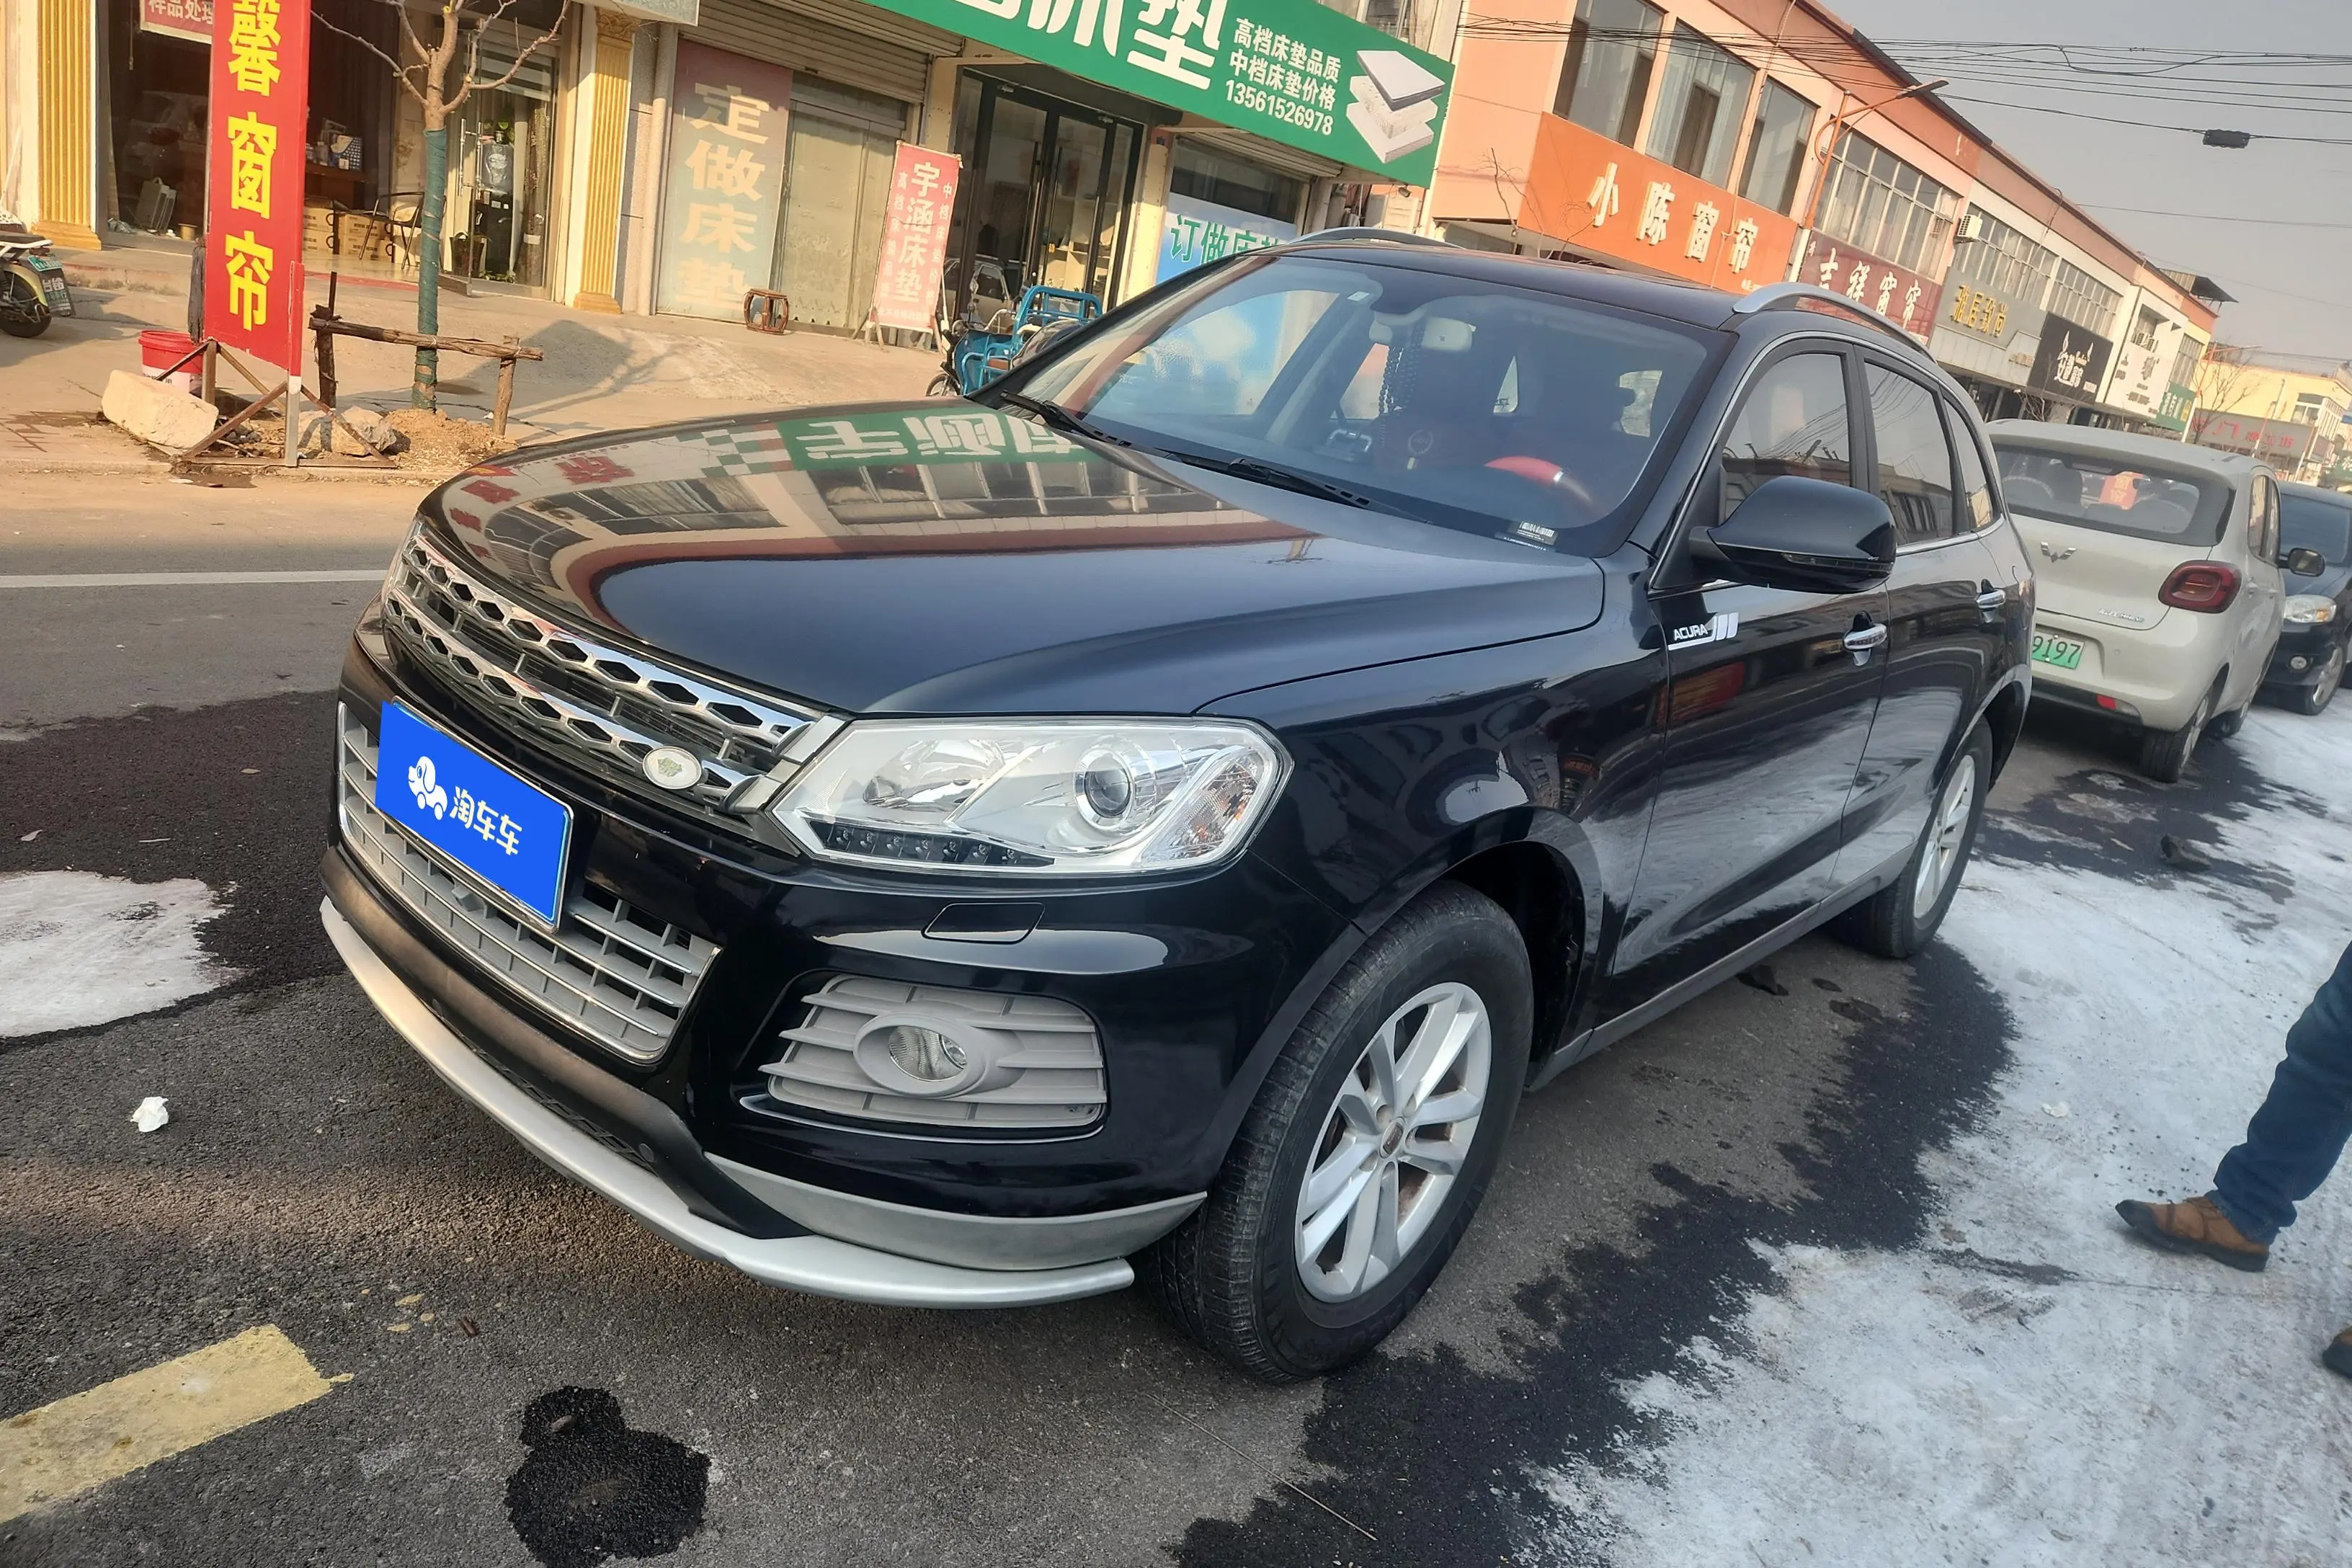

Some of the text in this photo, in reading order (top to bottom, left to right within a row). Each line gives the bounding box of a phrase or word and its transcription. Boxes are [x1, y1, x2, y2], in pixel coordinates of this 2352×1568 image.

[1229, 48, 1336, 111] 中档床垫价格
[1234, 17, 1341, 84] 高档床垫品质
[1226, 79, 1334, 135] 13561526978
[675, 81, 770, 309] 定做床垫
[1587, 161, 1760, 274] 小陈窗帘
[893, 161, 940, 303] 宇涵床垫
[1170, 213, 1280, 264] 订做床
[1673, 623, 1709, 641] ACURA
[2032, 635, 2082, 664] 9197
